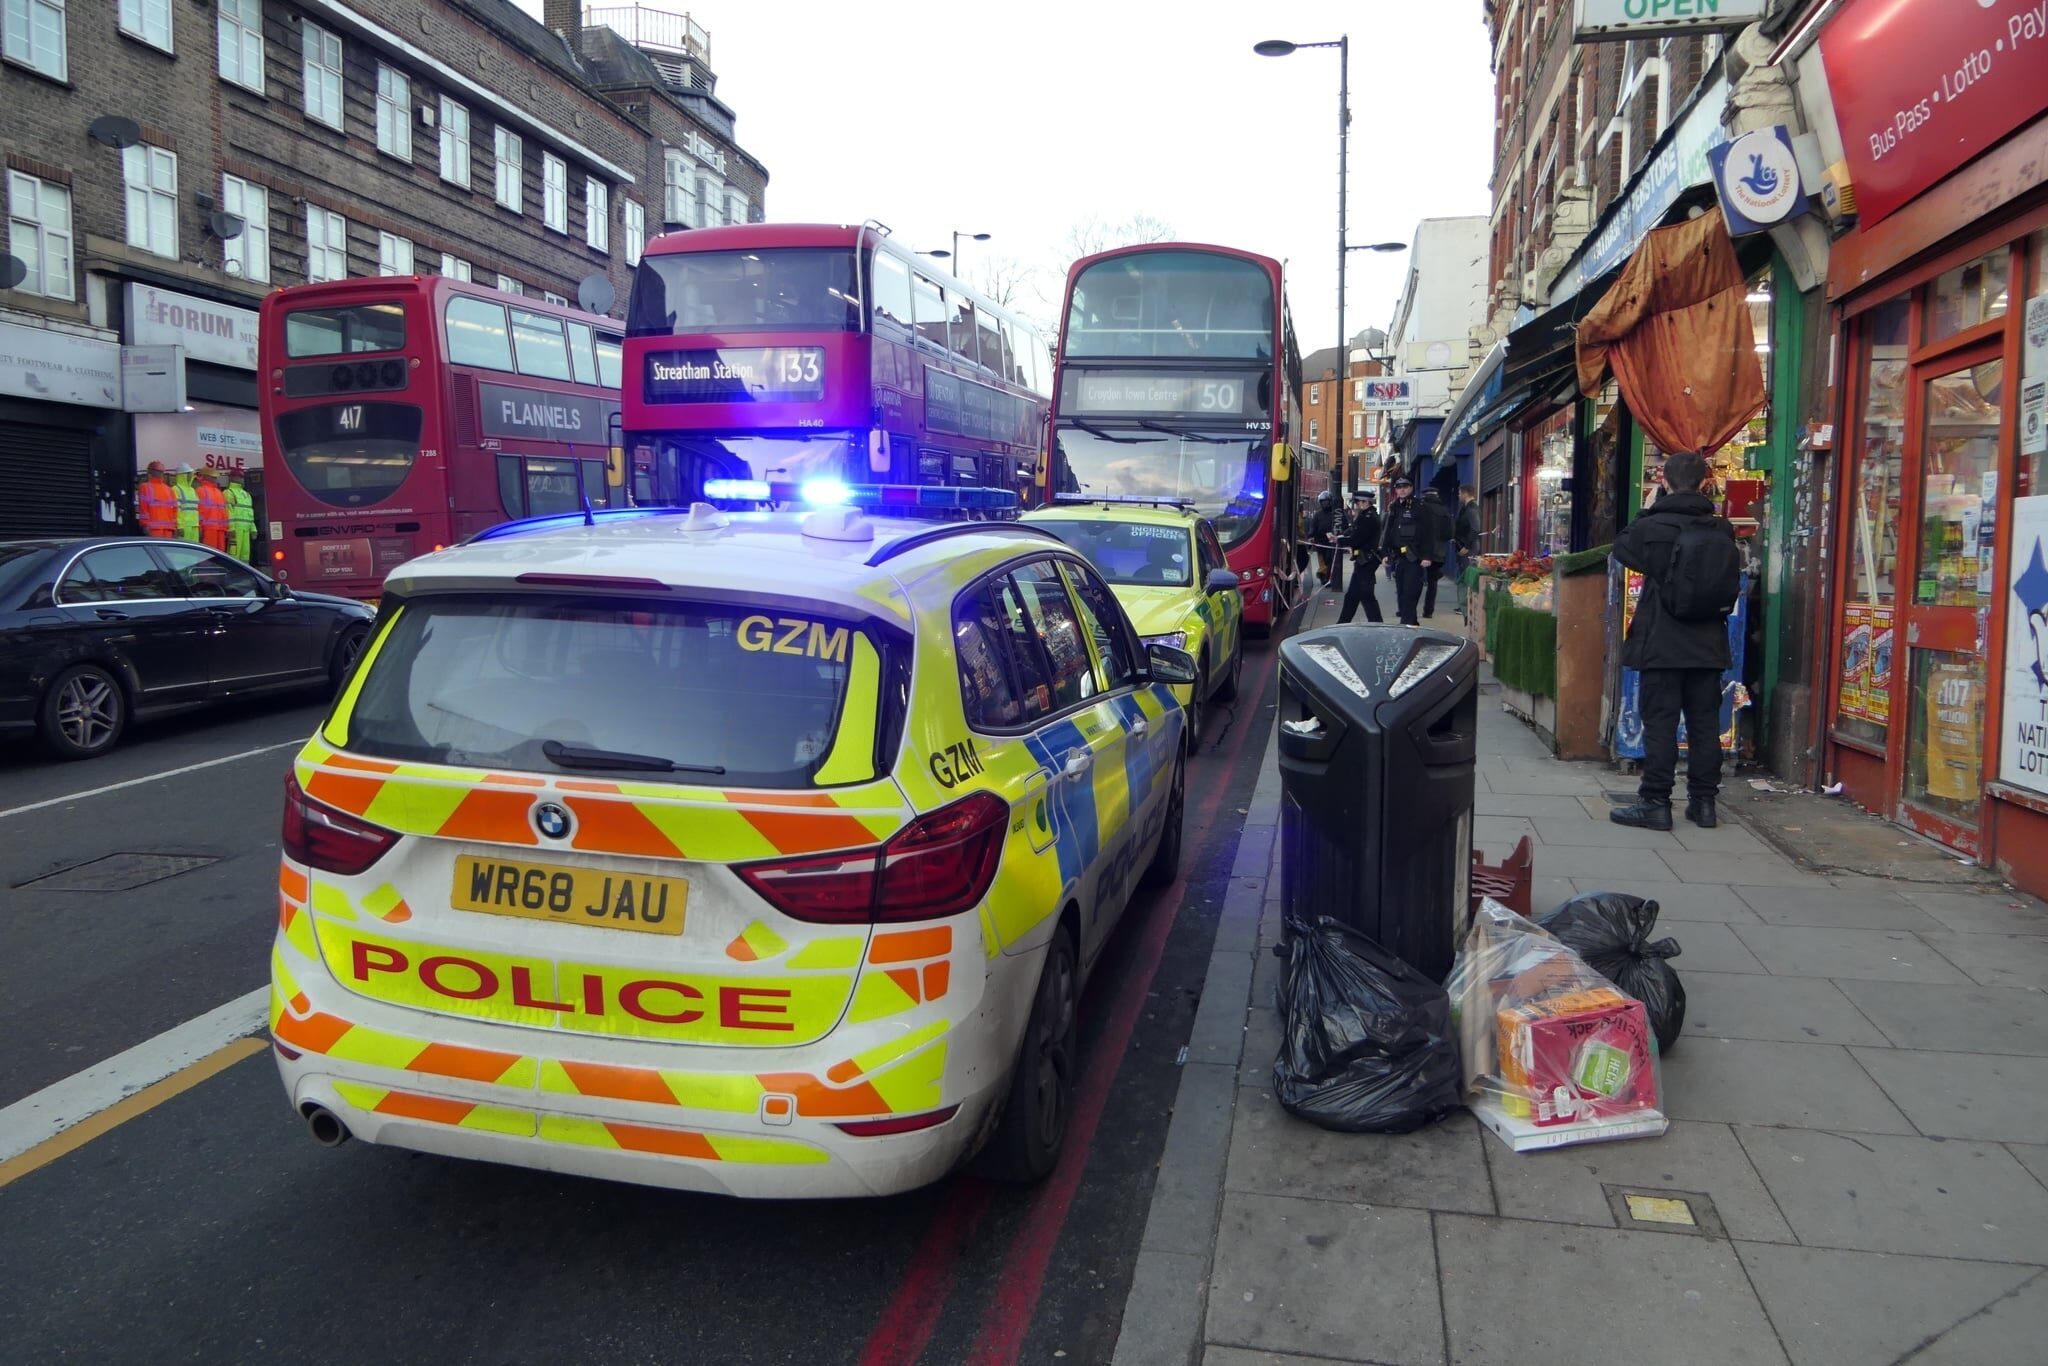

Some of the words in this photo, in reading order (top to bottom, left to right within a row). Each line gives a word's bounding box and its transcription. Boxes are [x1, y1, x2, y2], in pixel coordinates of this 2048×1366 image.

[1624, 0, 1718, 19] OPEN
[1869, 126, 1896, 161] Bus
[1895, 98, 1931, 140] Pass
[1942, 49, 1992, 103] Lotto
[2008, 0, 2048, 50] Pay
[1735, 185, 1746, 199] The
[1744, 194, 1781, 208] National
[1778, 168, 1791, 199] Lottery
[158, 302, 234, 339] FORUM
[17, 357, 63, 372] FOOTWEAR
[74, 367, 114, 380] CLOTHING
[653, 361, 710, 380] Streatham
[713, 360, 753, 380] Station
[780, 352, 819, 383] 133
[1088, 386, 1122, 402] Croydon
[1124, 387, 1145, 400] Town
[1148, 387, 1178, 401] Centre
[1201, 383, 1234, 410] 50
[339, 405, 362, 429] 417
[502, 400, 581, 430] FLANNELS
[799, 419, 823, 428] HA40
[1246, 421, 1259, 430] HV
[1261, 422, 1271, 430] 33
[200, 431, 216, 442] WEB
[205, 453, 245, 470] SALE
[319, 524, 376, 536] ENVIRO
[1130, 531, 1177, 540] OFFICER
[1131, 526, 1180, 536] INCIDENT
[736, 615, 849, 663] GZM
[929, 738, 985, 789] GZM
[470, 862, 573, 913] WR68
[585, 877, 668, 924] JAU
[351, 939, 796, 1031] POLICE
[1604, 1057, 1621, 1086] HECK
